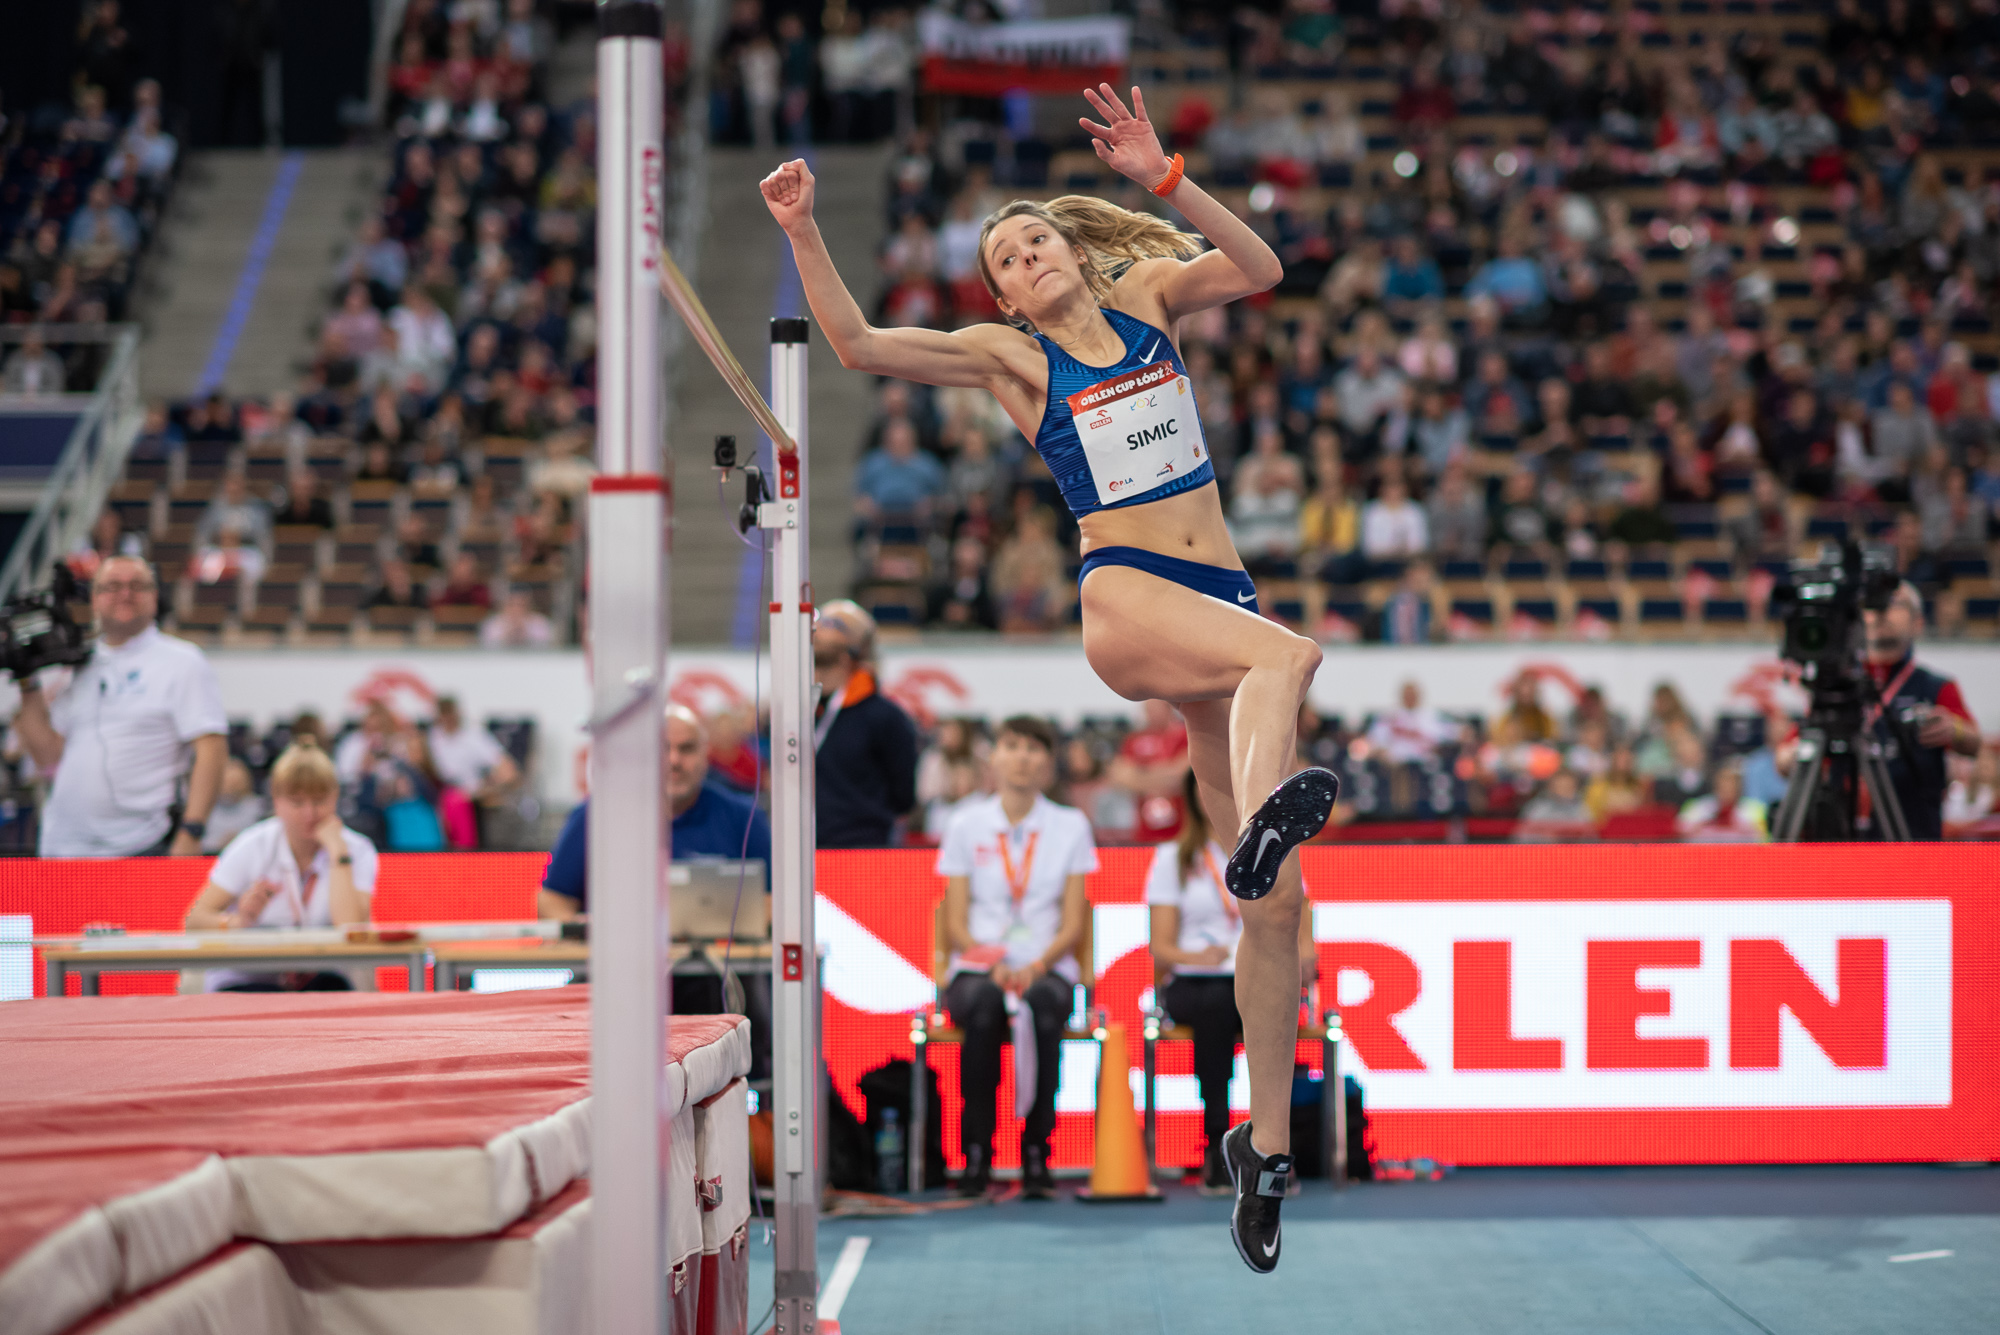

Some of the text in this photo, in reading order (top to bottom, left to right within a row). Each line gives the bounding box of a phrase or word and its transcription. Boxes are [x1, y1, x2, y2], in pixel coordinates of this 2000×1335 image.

[1081, 387, 1115, 406] ORLEN
[1115, 379, 1136, 394] CUP
[1136, 366, 1165, 387] ŁÓDŹ
[1091, 418, 1111, 429] ORLEN
[1126, 419, 1179, 450] SIMIC
[1090, 937, 1888, 1072] RLEN
